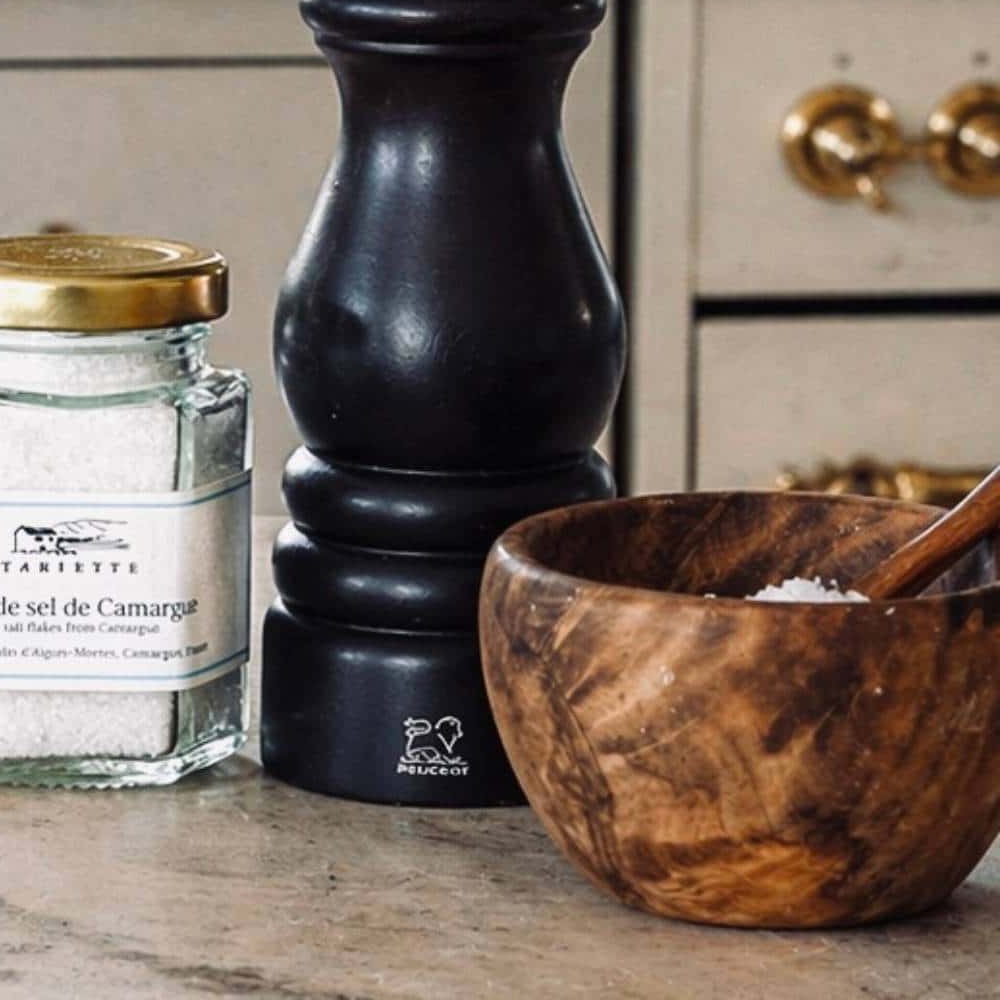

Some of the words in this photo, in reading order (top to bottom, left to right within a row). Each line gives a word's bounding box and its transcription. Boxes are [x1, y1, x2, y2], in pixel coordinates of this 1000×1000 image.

[0, 561, 139, 574] TARIETTE
[26, 598, 56, 616] sel
[63, 598, 91, 617] de
[27, 621, 63, 633] flakes
